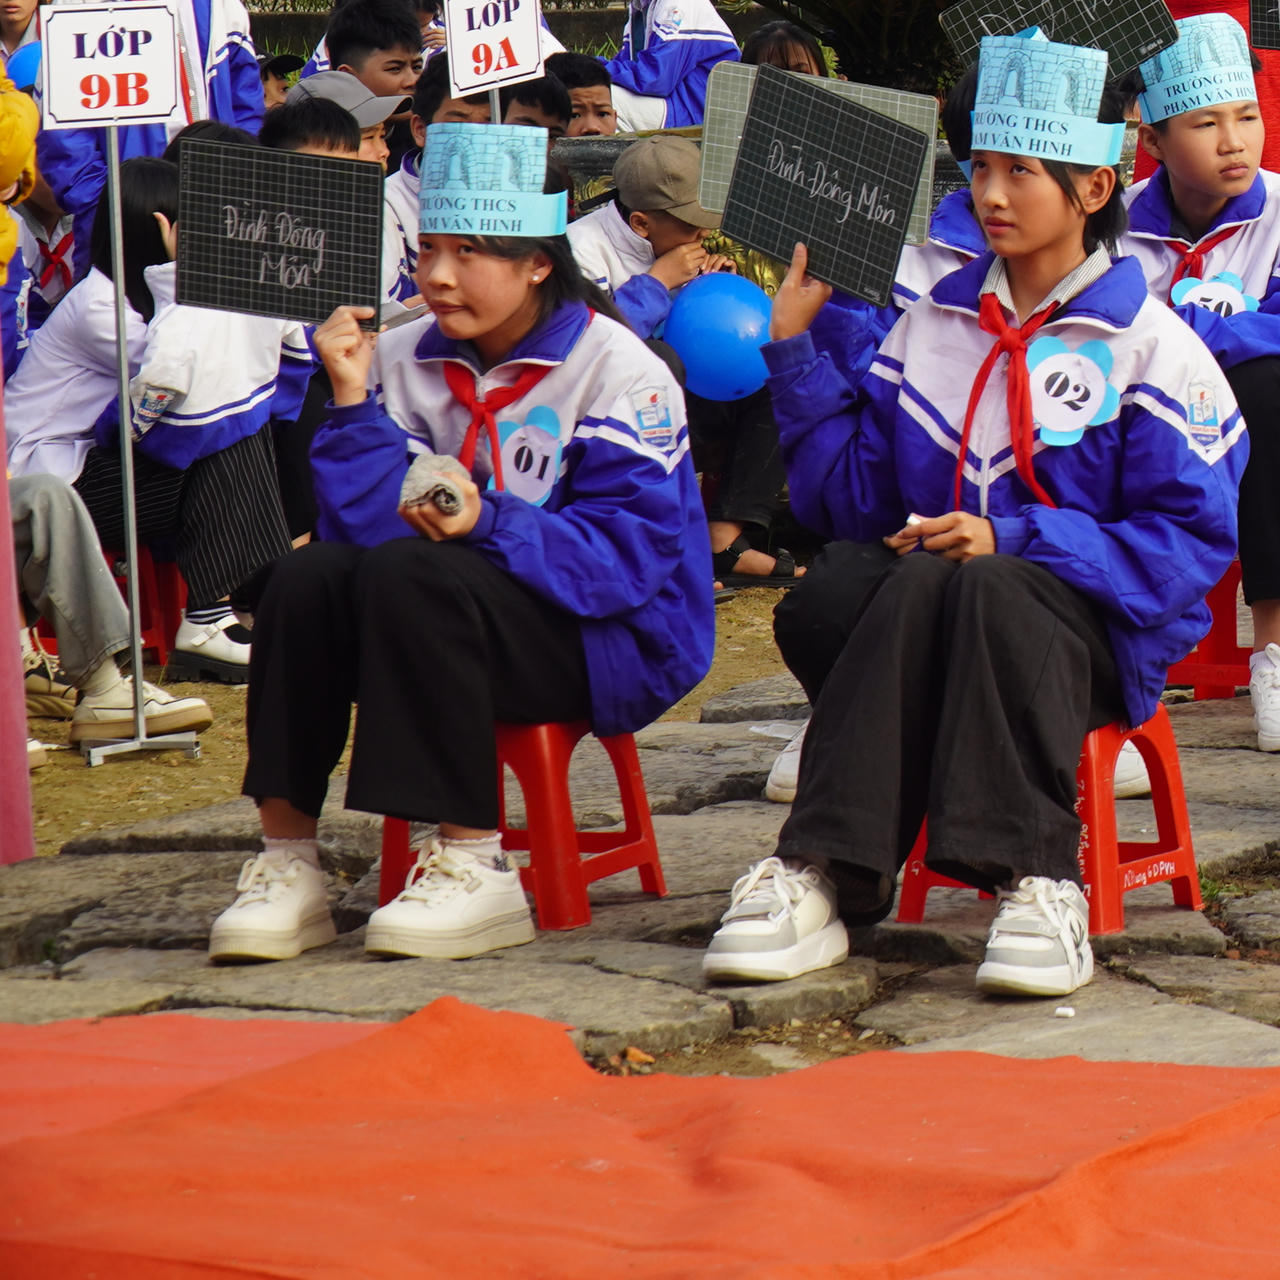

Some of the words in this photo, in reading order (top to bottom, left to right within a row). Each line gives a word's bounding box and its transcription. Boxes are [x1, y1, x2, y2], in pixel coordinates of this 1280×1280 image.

[74, 23, 153, 61] LỚP
[471, 36, 521, 77] 9A
[79, 73, 150, 110] 9B
[1163, 72, 1223, 98] TRƯỜNG
[1162, 94, 1202, 117] PHẠM
[1023, 115, 1070, 136] THCS
[991, 130, 1024, 149] VĂN
[1028, 137, 1073, 157] HINH
[470, 198, 517, 213] THCS
[807, 160, 853, 224] Đông
[856, 182, 896, 225] Môn
[442, 214, 473, 231] VĂN
[479, 219, 522, 233] HINH
[1044, 370, 1093, 411] 02
[514, 444, 550, 481] 01
